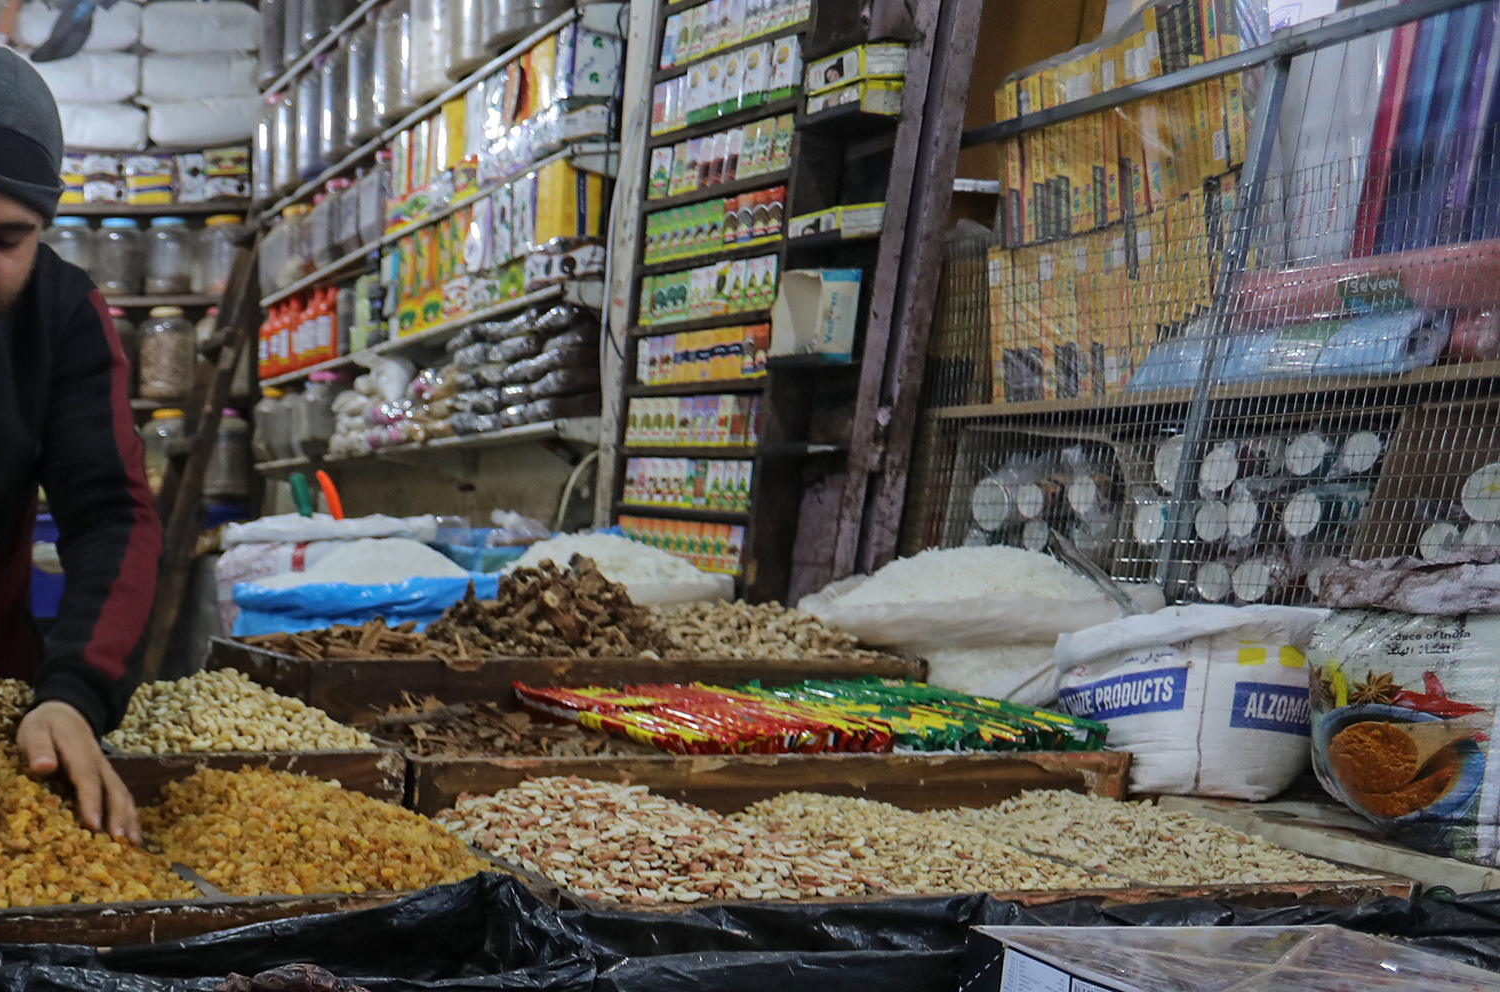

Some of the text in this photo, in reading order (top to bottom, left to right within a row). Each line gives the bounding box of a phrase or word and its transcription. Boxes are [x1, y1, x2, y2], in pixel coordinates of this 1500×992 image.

[1426, 631, 1436, 640] of
[1440, 629, 1470, 639] India
[1095, 676, 1174, 712] PRODUCTS
[1244, 692, 1311, 724] ALZOMO
